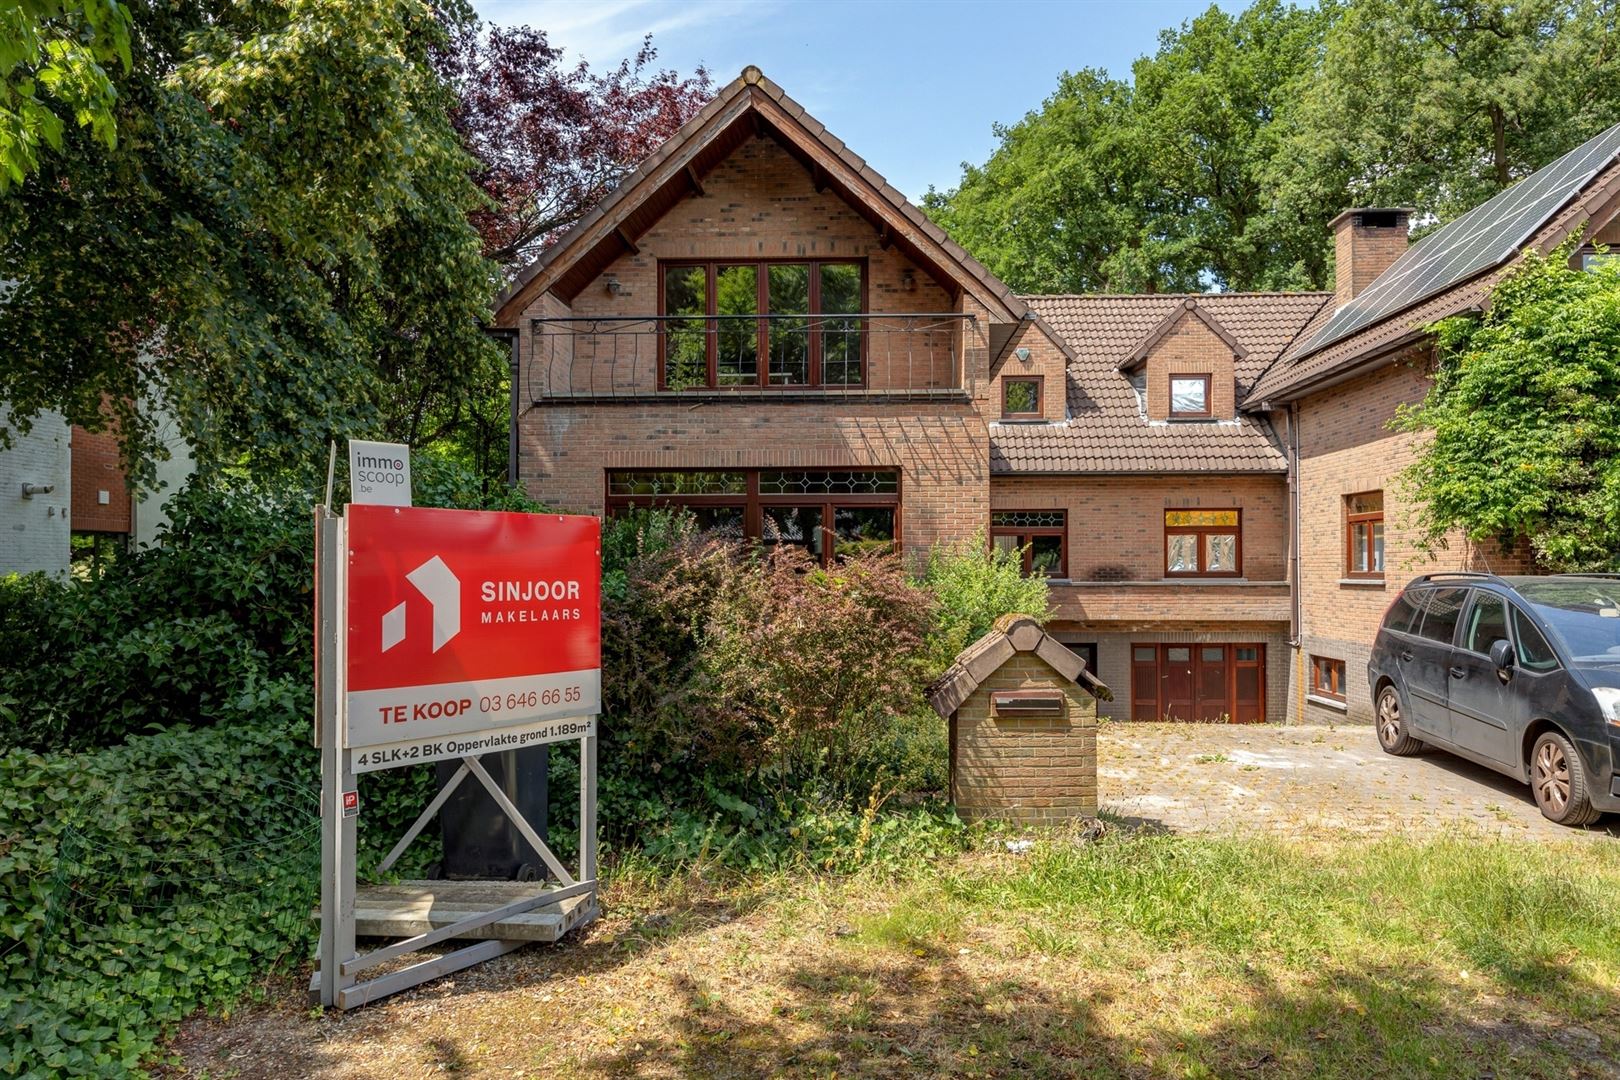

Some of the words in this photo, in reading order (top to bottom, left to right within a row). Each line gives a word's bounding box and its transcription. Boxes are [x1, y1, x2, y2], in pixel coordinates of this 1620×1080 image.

[357, 451, 403, 470] immo
[358, 471, 404, 487] scoop
[481, 581, 579, 602] SINJOOR
[481, 608, 580, 624] MAKELAARS
[379, 705, 407, 724] TE
[413, 699, 472, 720] KOOP
[480, 695, 501, 712] 03
[507, 692, 537, 709] 646
[542, 688, 560, 705] 66
[565, 686, 580, 702] 55
[358, 754, 368, 766] 4
[372, 746, 419, 764] SLK+2
[423, 743, 443, 756] BK
[446, 733, 518, 753] Oppervlakte
[520, 727, 548, 744] grond
